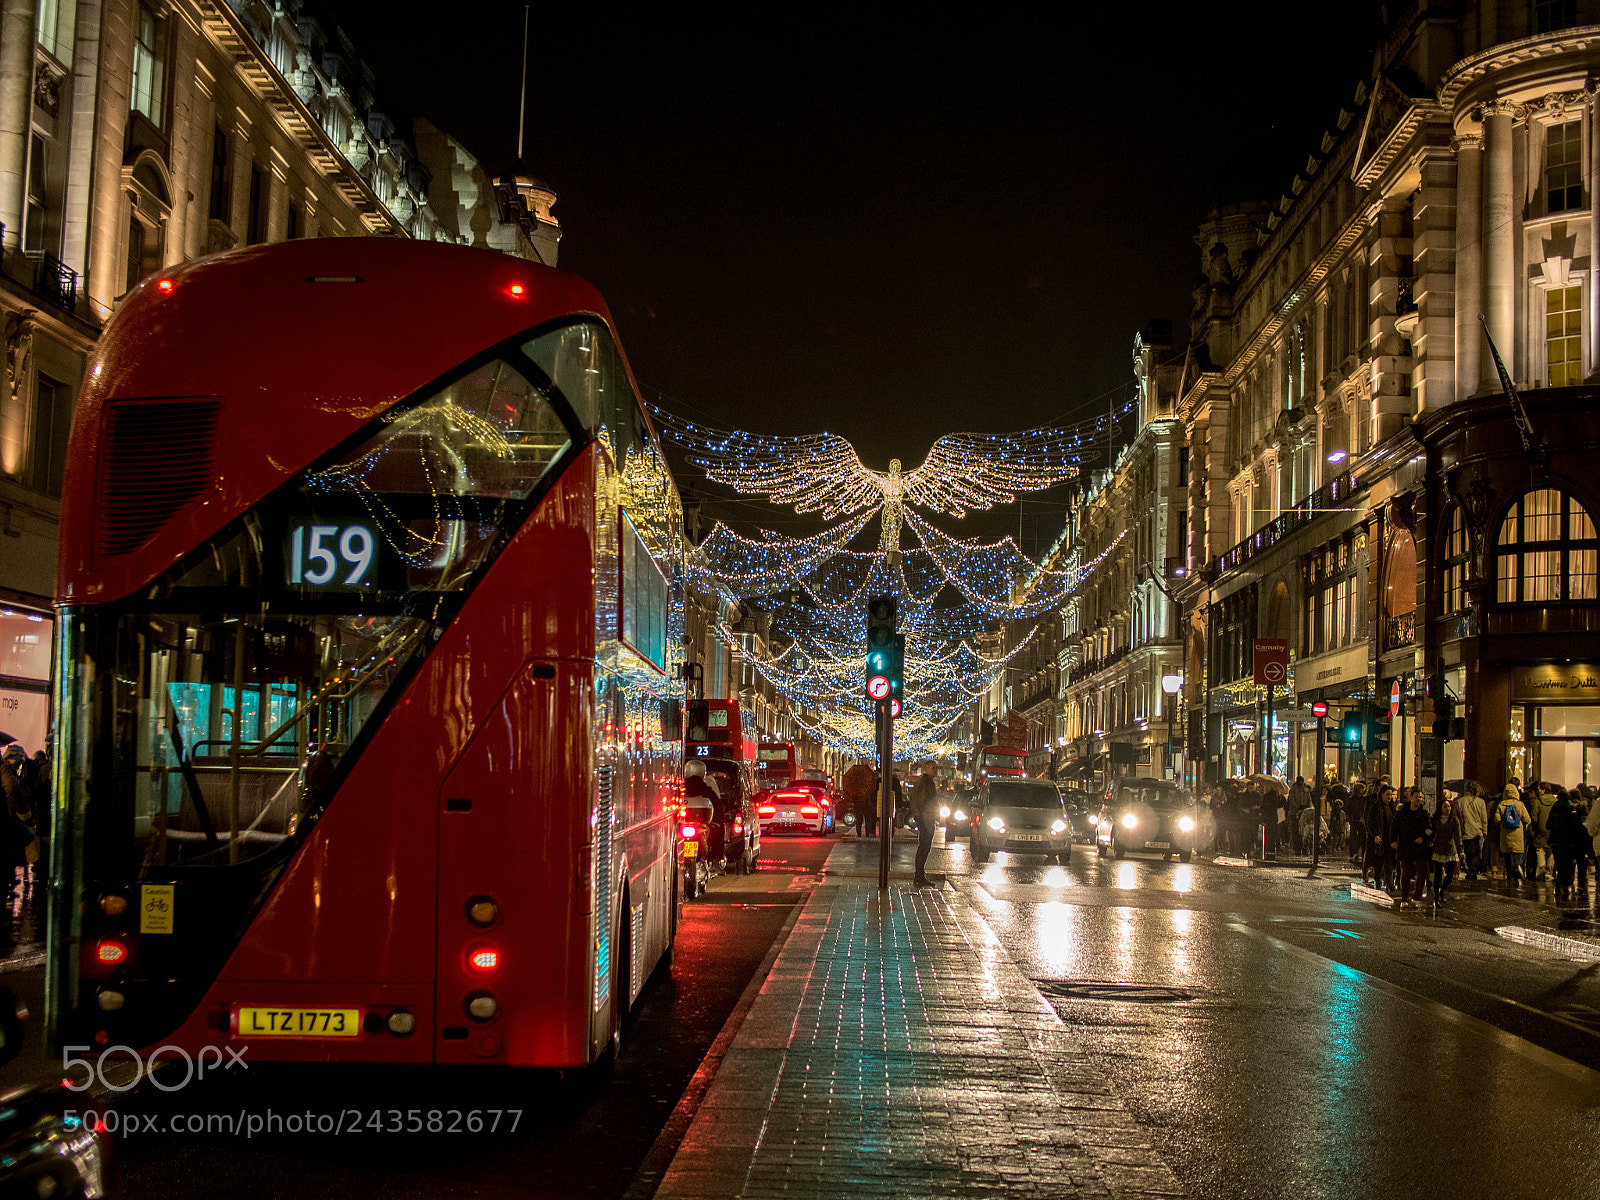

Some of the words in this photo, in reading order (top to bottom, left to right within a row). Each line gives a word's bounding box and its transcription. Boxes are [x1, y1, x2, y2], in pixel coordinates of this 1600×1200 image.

[291, 525, 374, 585] 159
[1570, 676, 1598, 688] Dutti
[3, 697, 18, 711] maje
[697, 745, 709, 756] 23
